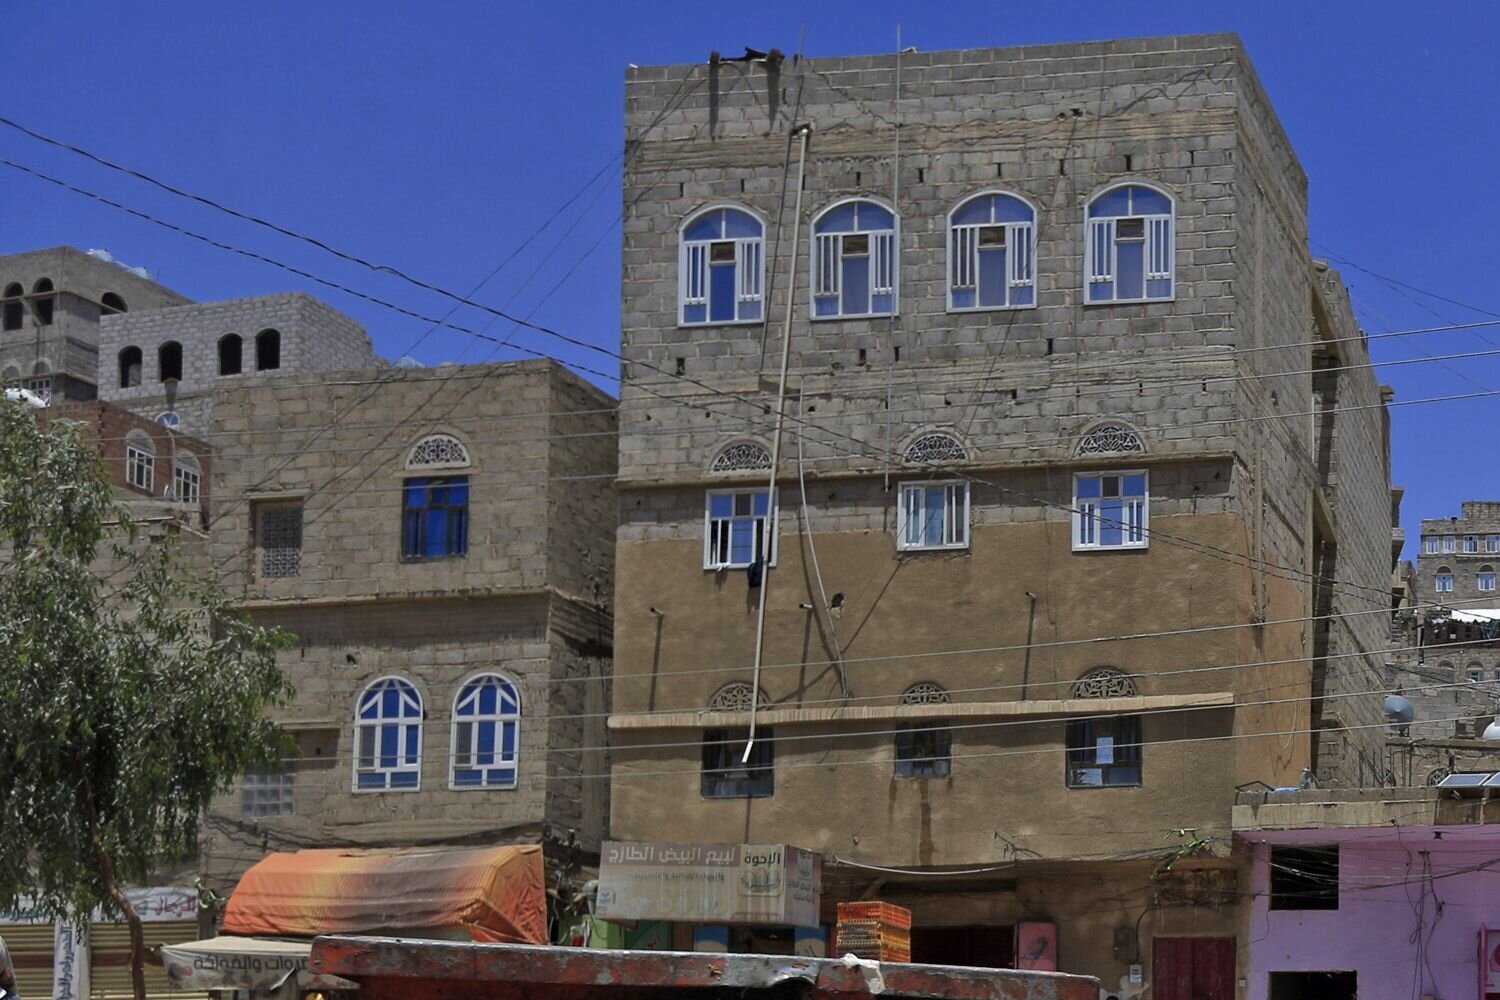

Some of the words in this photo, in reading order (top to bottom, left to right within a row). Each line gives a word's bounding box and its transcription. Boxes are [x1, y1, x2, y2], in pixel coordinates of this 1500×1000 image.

[609, 845, 653, 863] الطازج
[659, 847, 701, 865] البيض
[705, 847, 735, 865] لبيع
